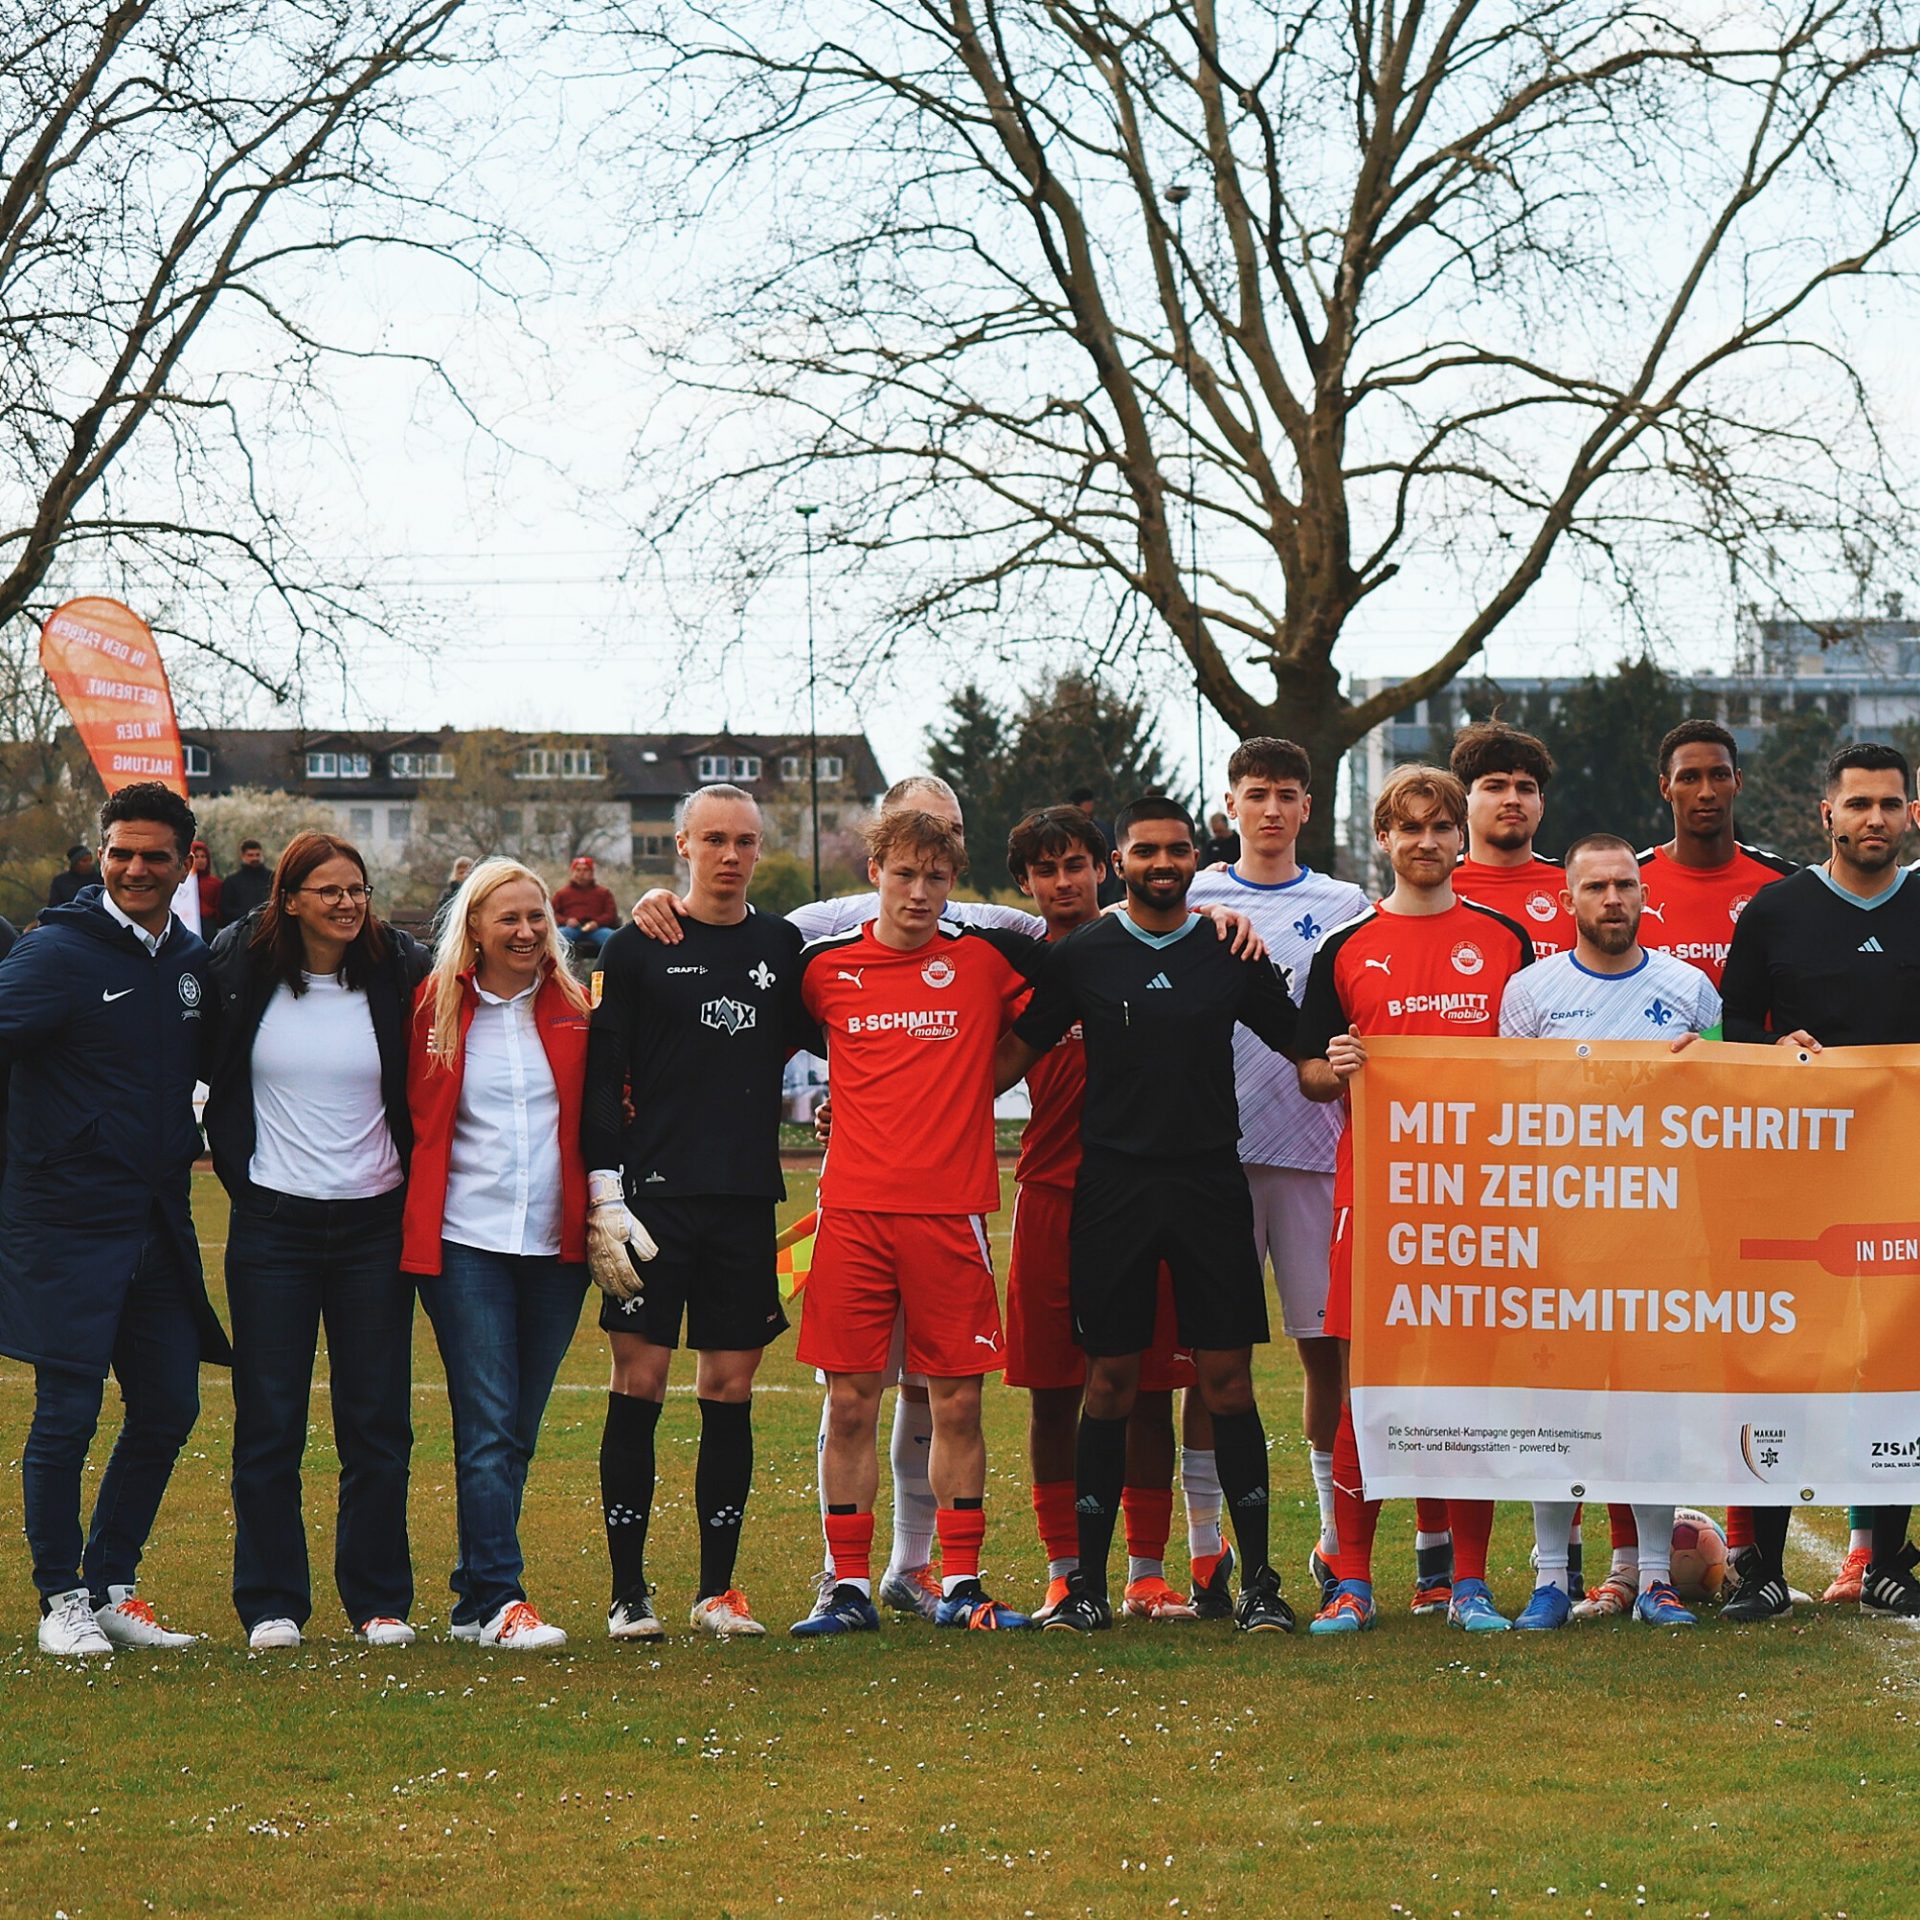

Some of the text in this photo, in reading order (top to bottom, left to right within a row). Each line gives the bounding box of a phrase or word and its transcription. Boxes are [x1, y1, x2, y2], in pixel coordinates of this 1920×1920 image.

[1448, 1009, 1484, 1020] mobile
[1551, 1010, 1585, 1020] CRAFT
[914, 1025, 953, 1037] mobile
[1389, 1101, 1855, 1151] MIT JEDEM SCHRITT
[1389, 1162, 1679, 1209] EIN ZEICHEN
[1387, 1222, 1539, 1269] GEGEN
[1856, 1239, 1918, 1262] IN DEN
[1384, 1283, 1797, 1334] ANTISEMITISMUS
[1388, 1426, 1602, 1440] Die Schnürsenkel-Kampagne gegen Antisemitismus
[1754, 1429, 1786, 1438] MAKKABI
[1388, 1441, 1396, 1450] in
[1398, 1441, 1424, 1452] Sport-
[1427, 1442, 1443, 1451] und
[1444, 1441, 1511, 1454] Bildungsstätten
[1519, 1443, 1556, 1454] powered
